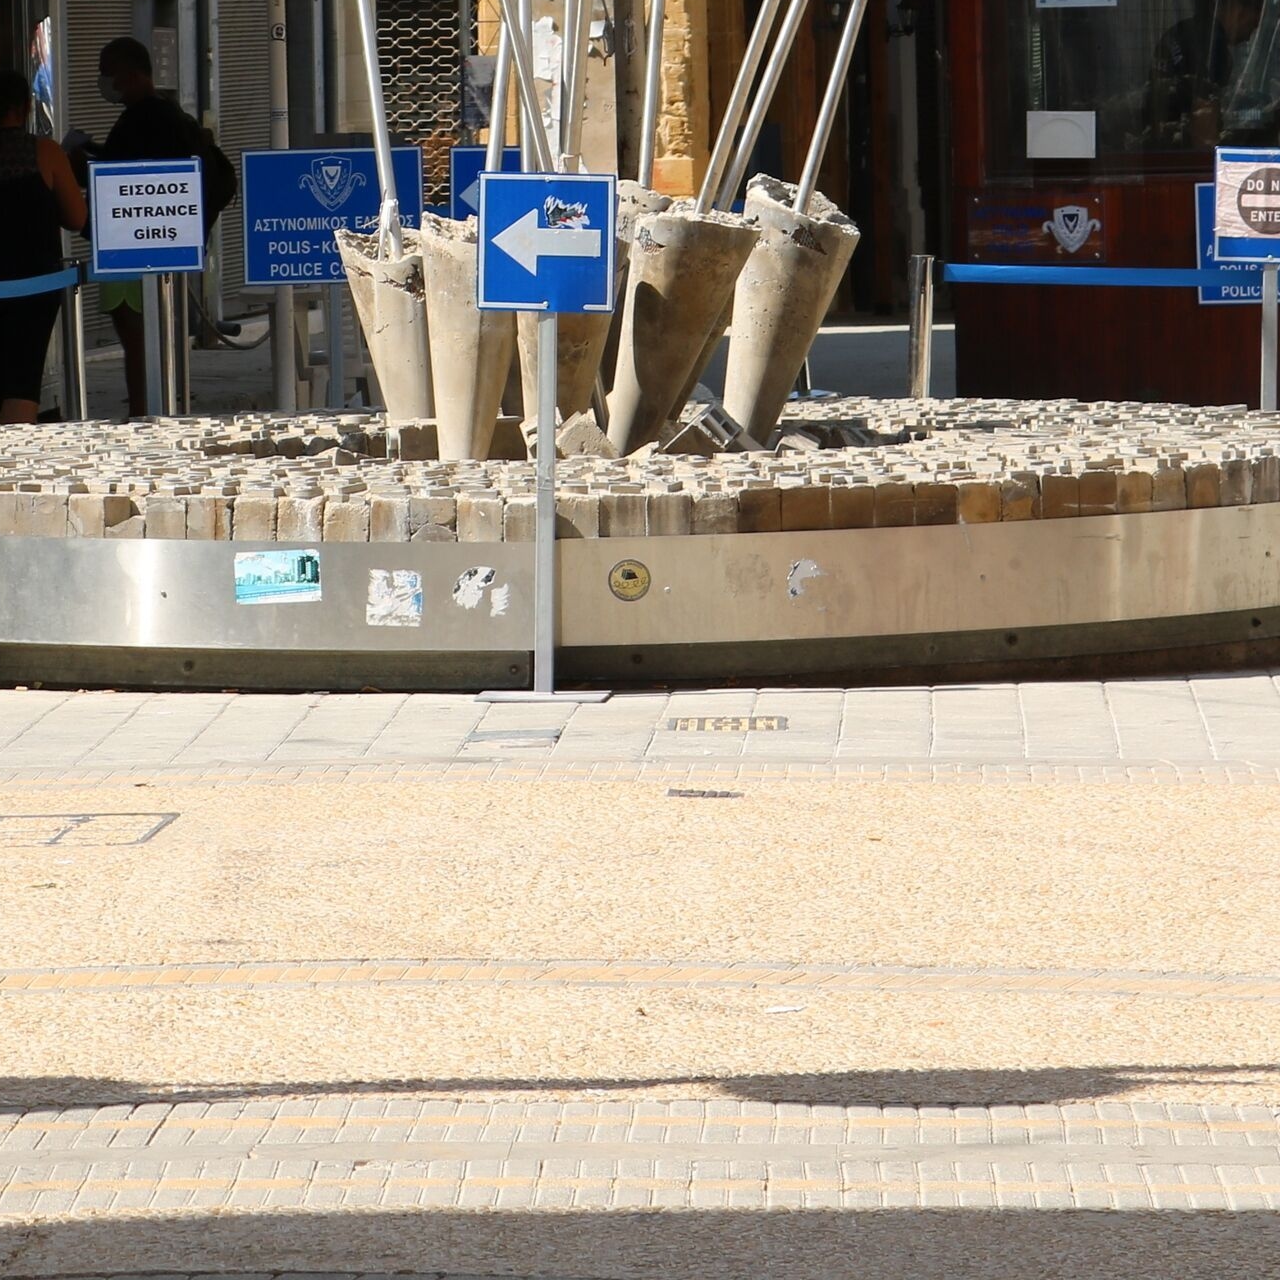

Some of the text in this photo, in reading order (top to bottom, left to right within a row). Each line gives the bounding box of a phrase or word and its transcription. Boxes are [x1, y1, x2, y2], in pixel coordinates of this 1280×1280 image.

[119, 182, 189, 196] ΕΙΣΟΔΟΣ
[1247, 179, 1264, 192] DO
[112, 204, 198, 218] ENTRANCE
[254, 216, 348, 232] ΑΣΤΥΝΟΜΙΚΟΣ
[134, 226, 177, 240] GİRİŞ
[270, 263, 323, 277] POLICE
[1222, 286, 1261, 297] POLIC
